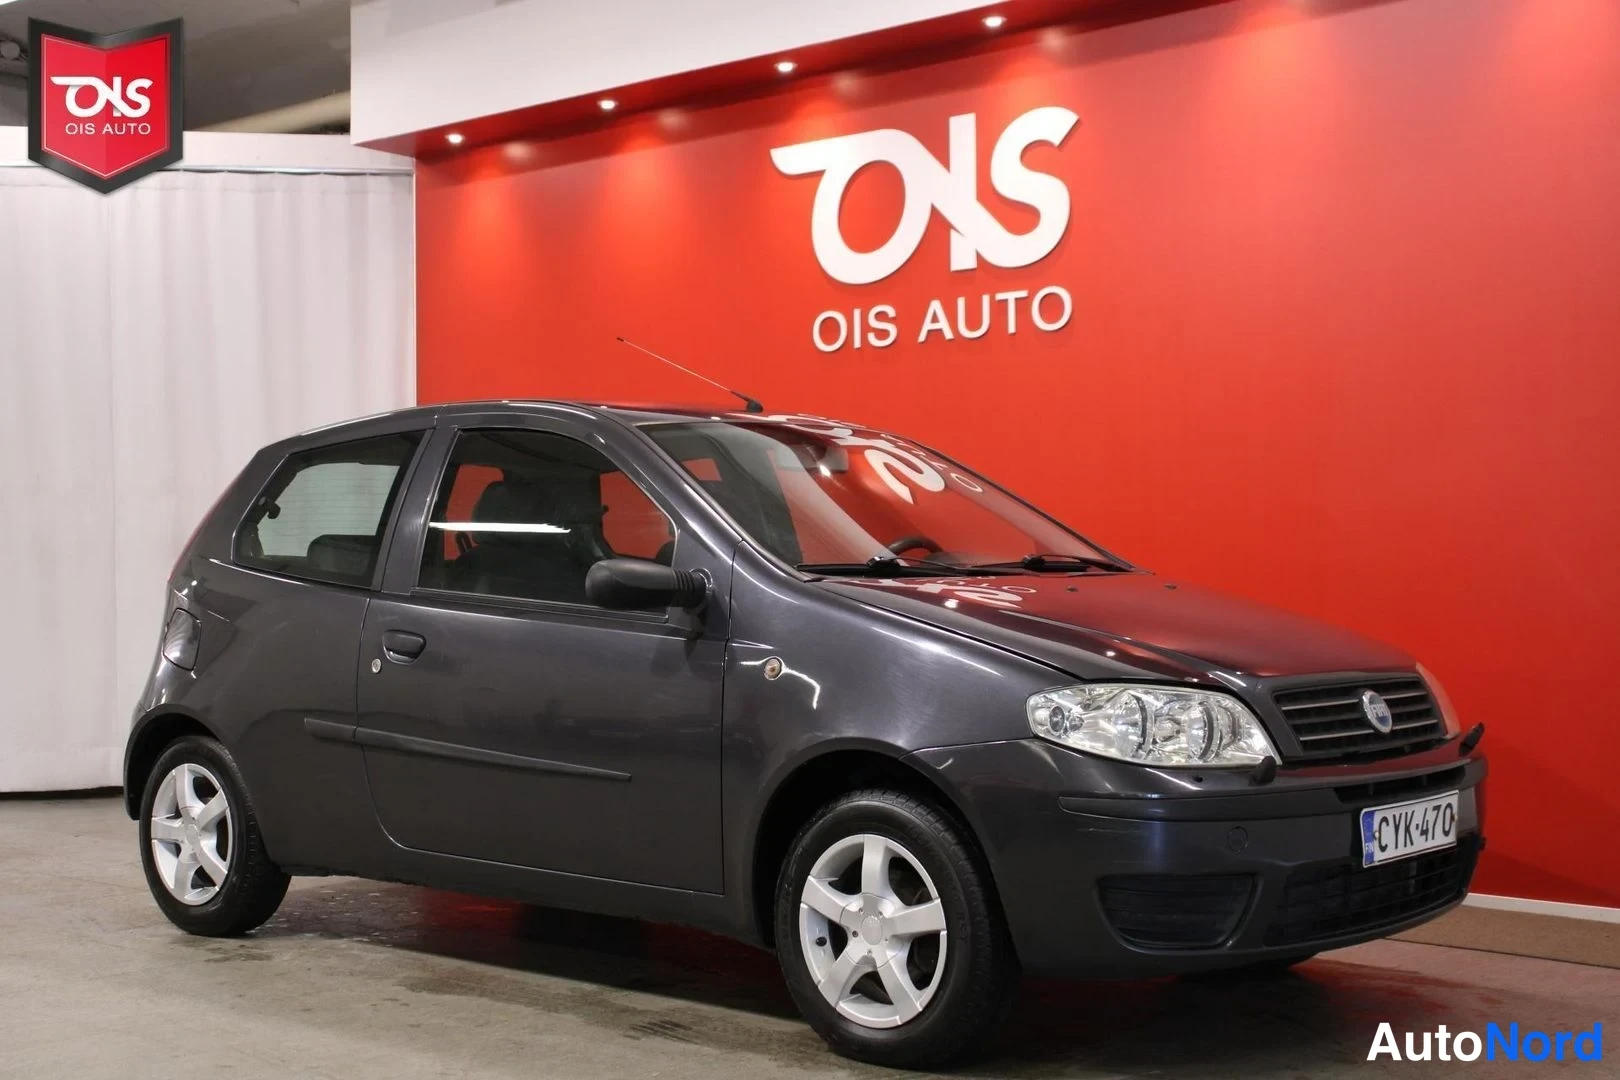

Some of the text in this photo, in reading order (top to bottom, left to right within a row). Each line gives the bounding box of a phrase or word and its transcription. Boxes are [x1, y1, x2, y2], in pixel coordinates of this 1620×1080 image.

[769, 105, 1080, 285] OIS
[812, 286, 1073, 353] OIS AUTO
[1377, 802, 1454, 853] CYK-470
